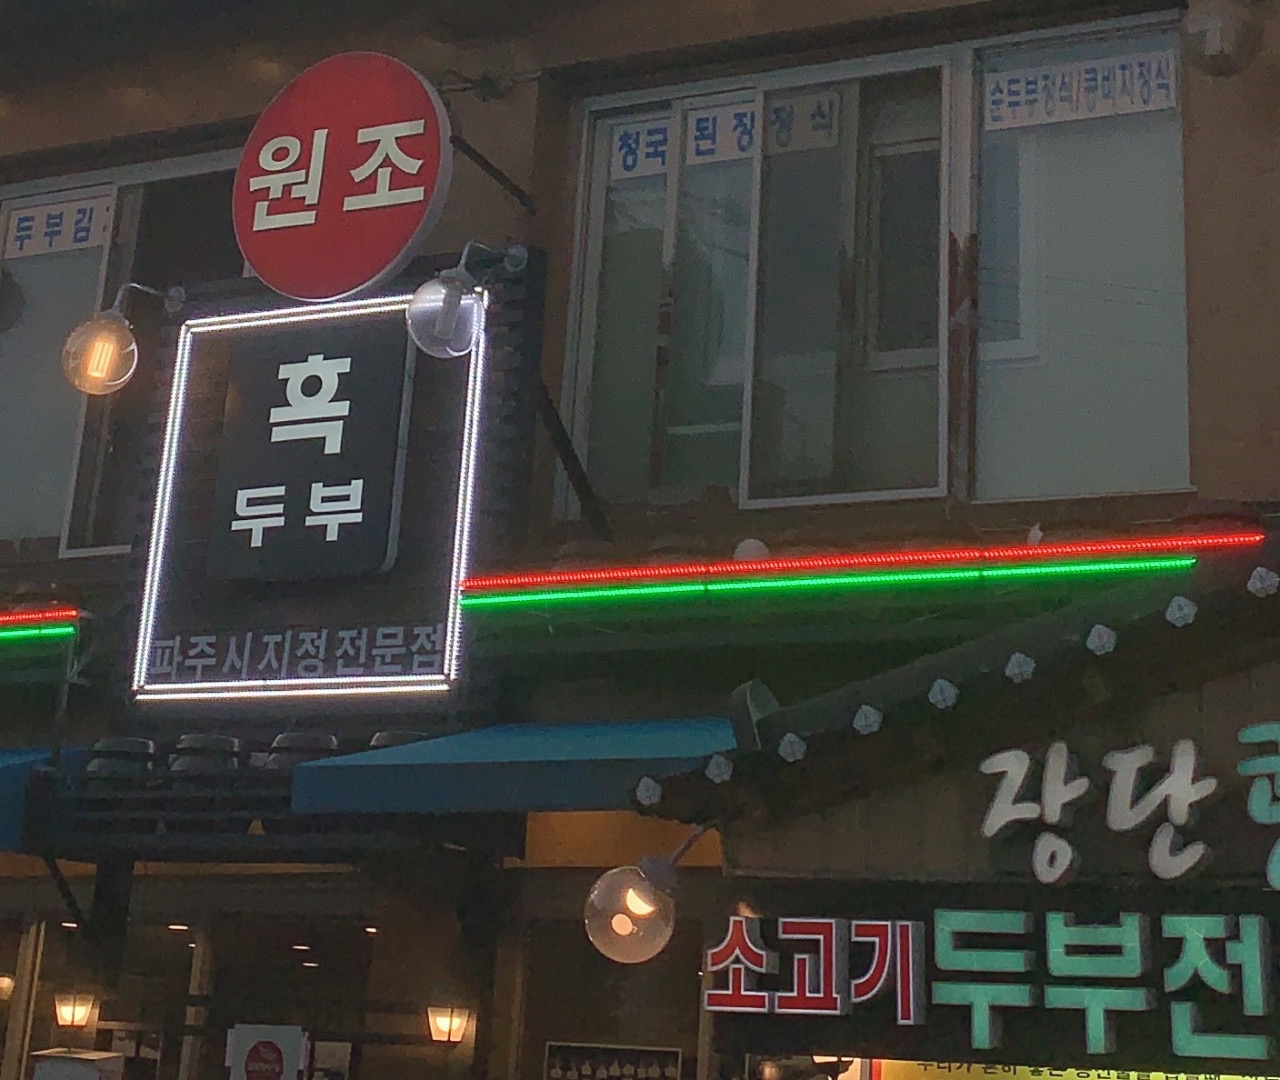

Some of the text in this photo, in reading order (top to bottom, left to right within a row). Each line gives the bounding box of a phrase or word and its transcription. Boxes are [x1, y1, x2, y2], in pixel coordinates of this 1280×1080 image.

[248, 119, 426, 232] 원조
[14, 205, 110, 251] 두부김
[268, 352, 352, 455] 흑
[230, 478, 364, 548] 두부
[702, 915, 921, 1026] 소고기
